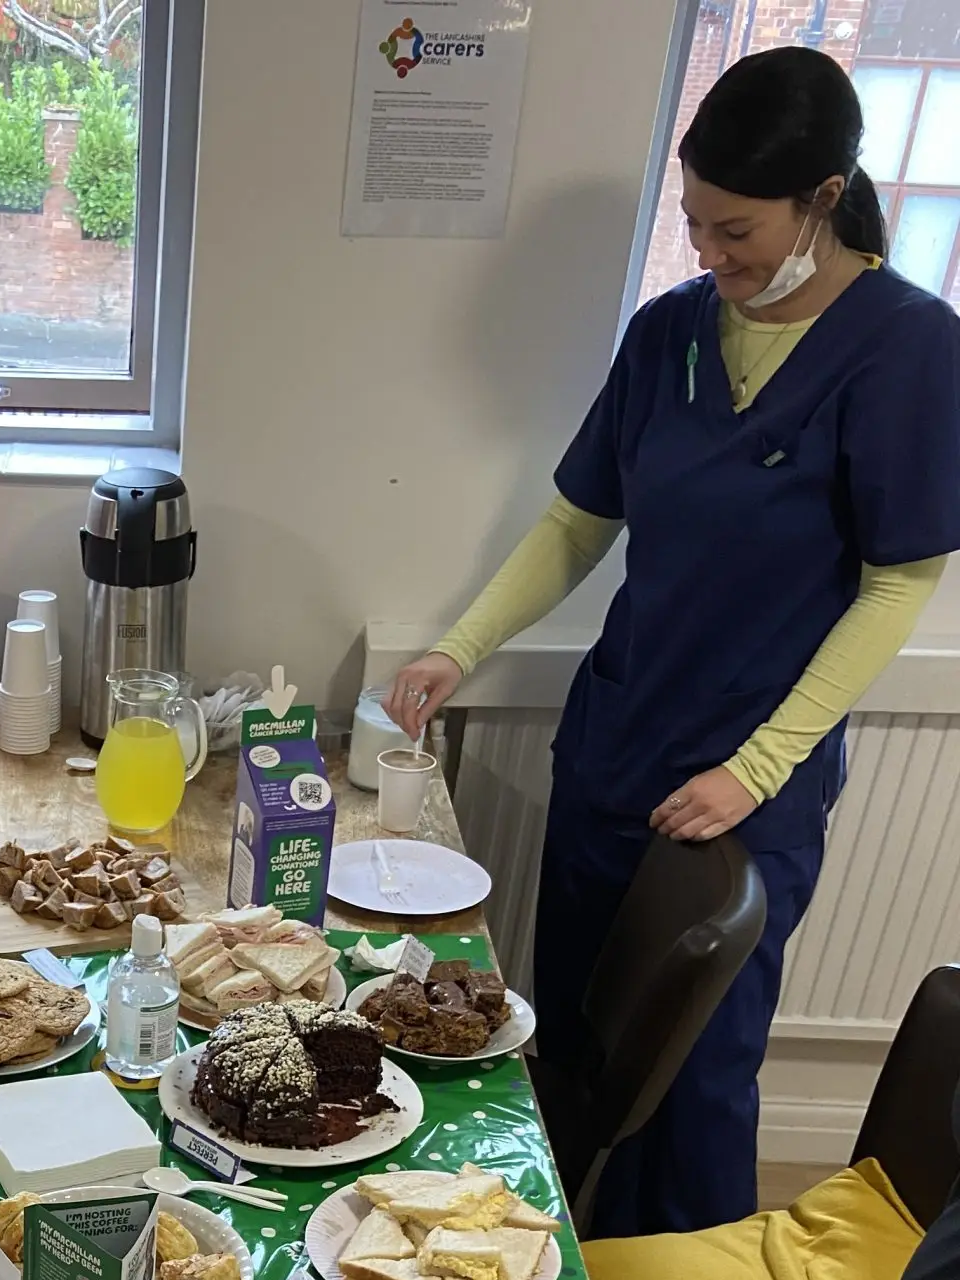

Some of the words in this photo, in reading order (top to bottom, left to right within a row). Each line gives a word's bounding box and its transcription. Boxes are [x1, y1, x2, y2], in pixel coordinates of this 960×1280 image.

[440, 33, 485, 41] LANCASHIRE
[423, 42, 484, 57] carers
[249, 720, 305, 732] MACMILLAN
[274, 728, 302, 736] SUPPORT
[280, 838, 318, 855] LIFE-
[270, 851, 322, 864] CHANGING
[271, 860, 320, 872] DONATIONS
[283, 869, 305, 882] GO
[275, 881, 312, 896] HERE
[187, 1140, 219, 1166] PERFECT
[66, 1213, 83, 1222] I'M
[84, 1208, 131, 1220] HOSTING
[92, 1217, 129, 1227] COFFEE
[115, 1224, 138, 1233] FOR:
[40, 1239, 52, 1252] MY
[53, 1228, 101, 1266] MACMILLAN
[40, 1230, 64, 1253] NURSE
[65, 1247, 81, 1263] HAS
[81, 1260, 103, 1276] BEEN
